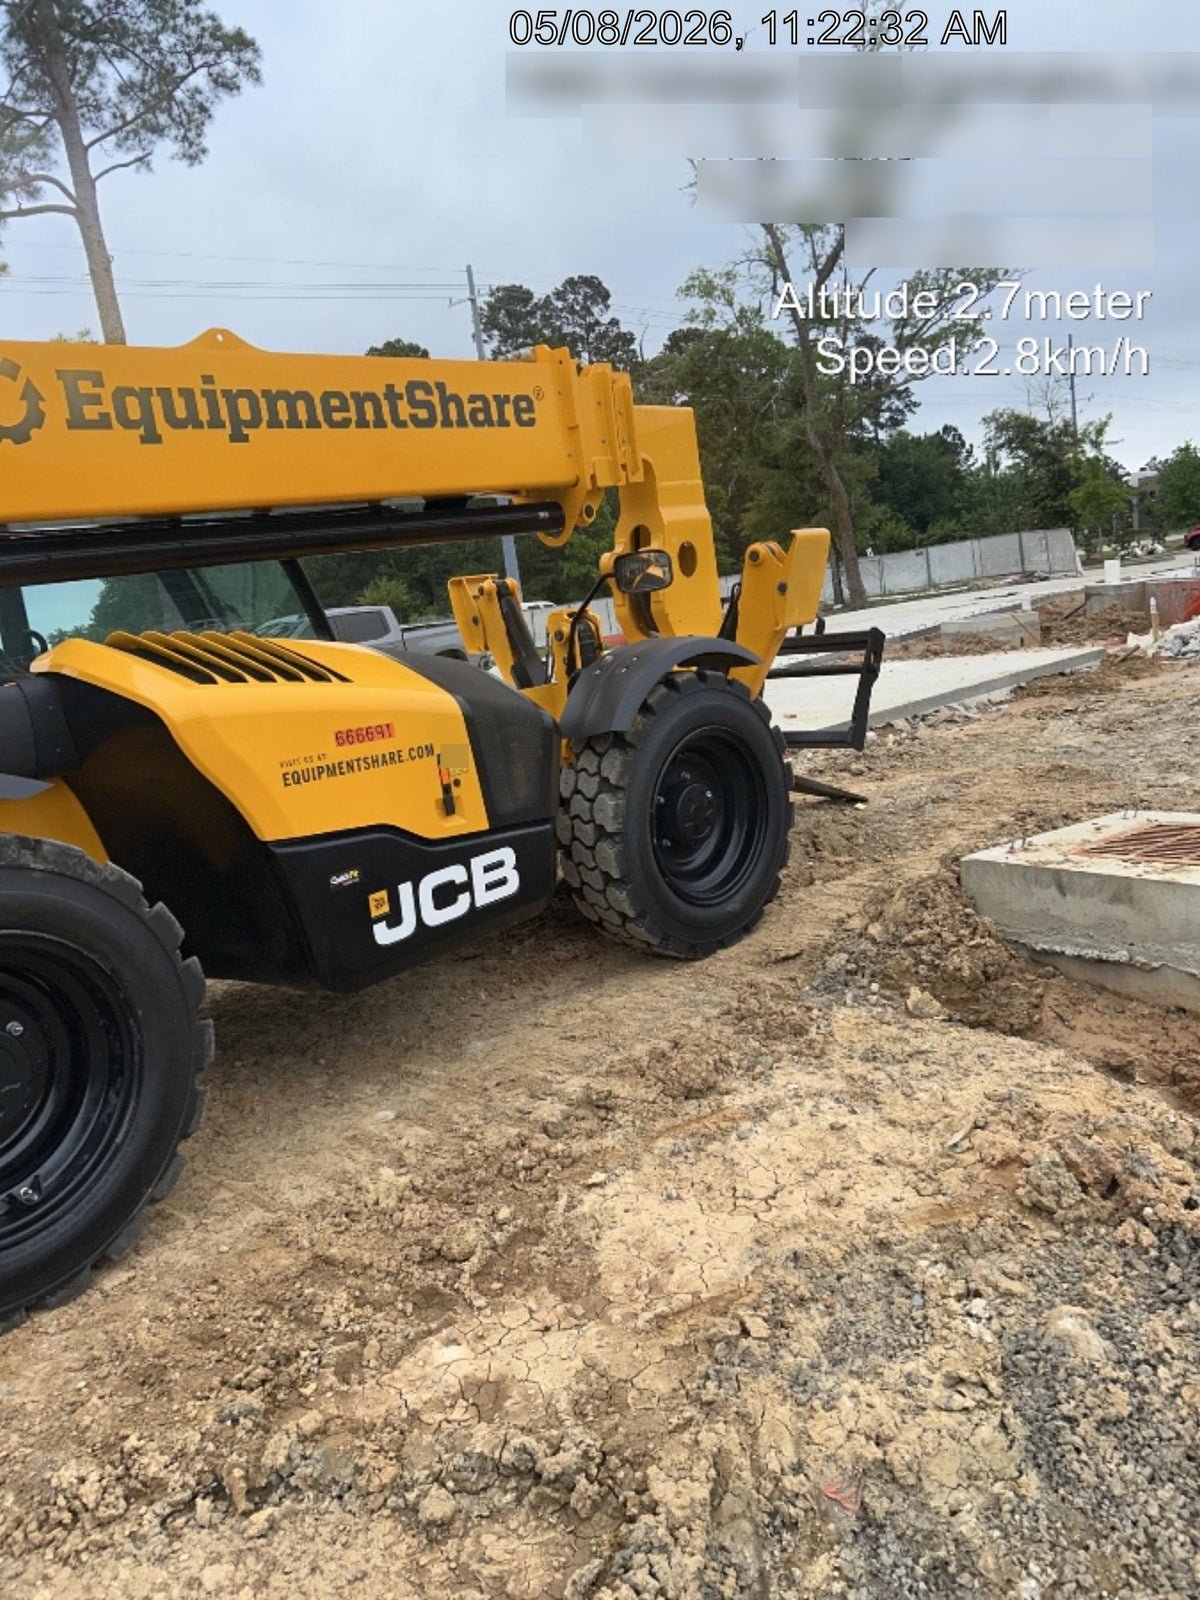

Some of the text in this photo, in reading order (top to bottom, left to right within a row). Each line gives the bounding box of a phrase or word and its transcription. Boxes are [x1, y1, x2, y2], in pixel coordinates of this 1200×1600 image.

[55, 369, 537, 445] EquipmentShare
[282, 743, 435, 788] EQUIPMENTSHARE.COM
[335, 723, 393, 748] 666691
[372, 846, 520, 946] JCB
